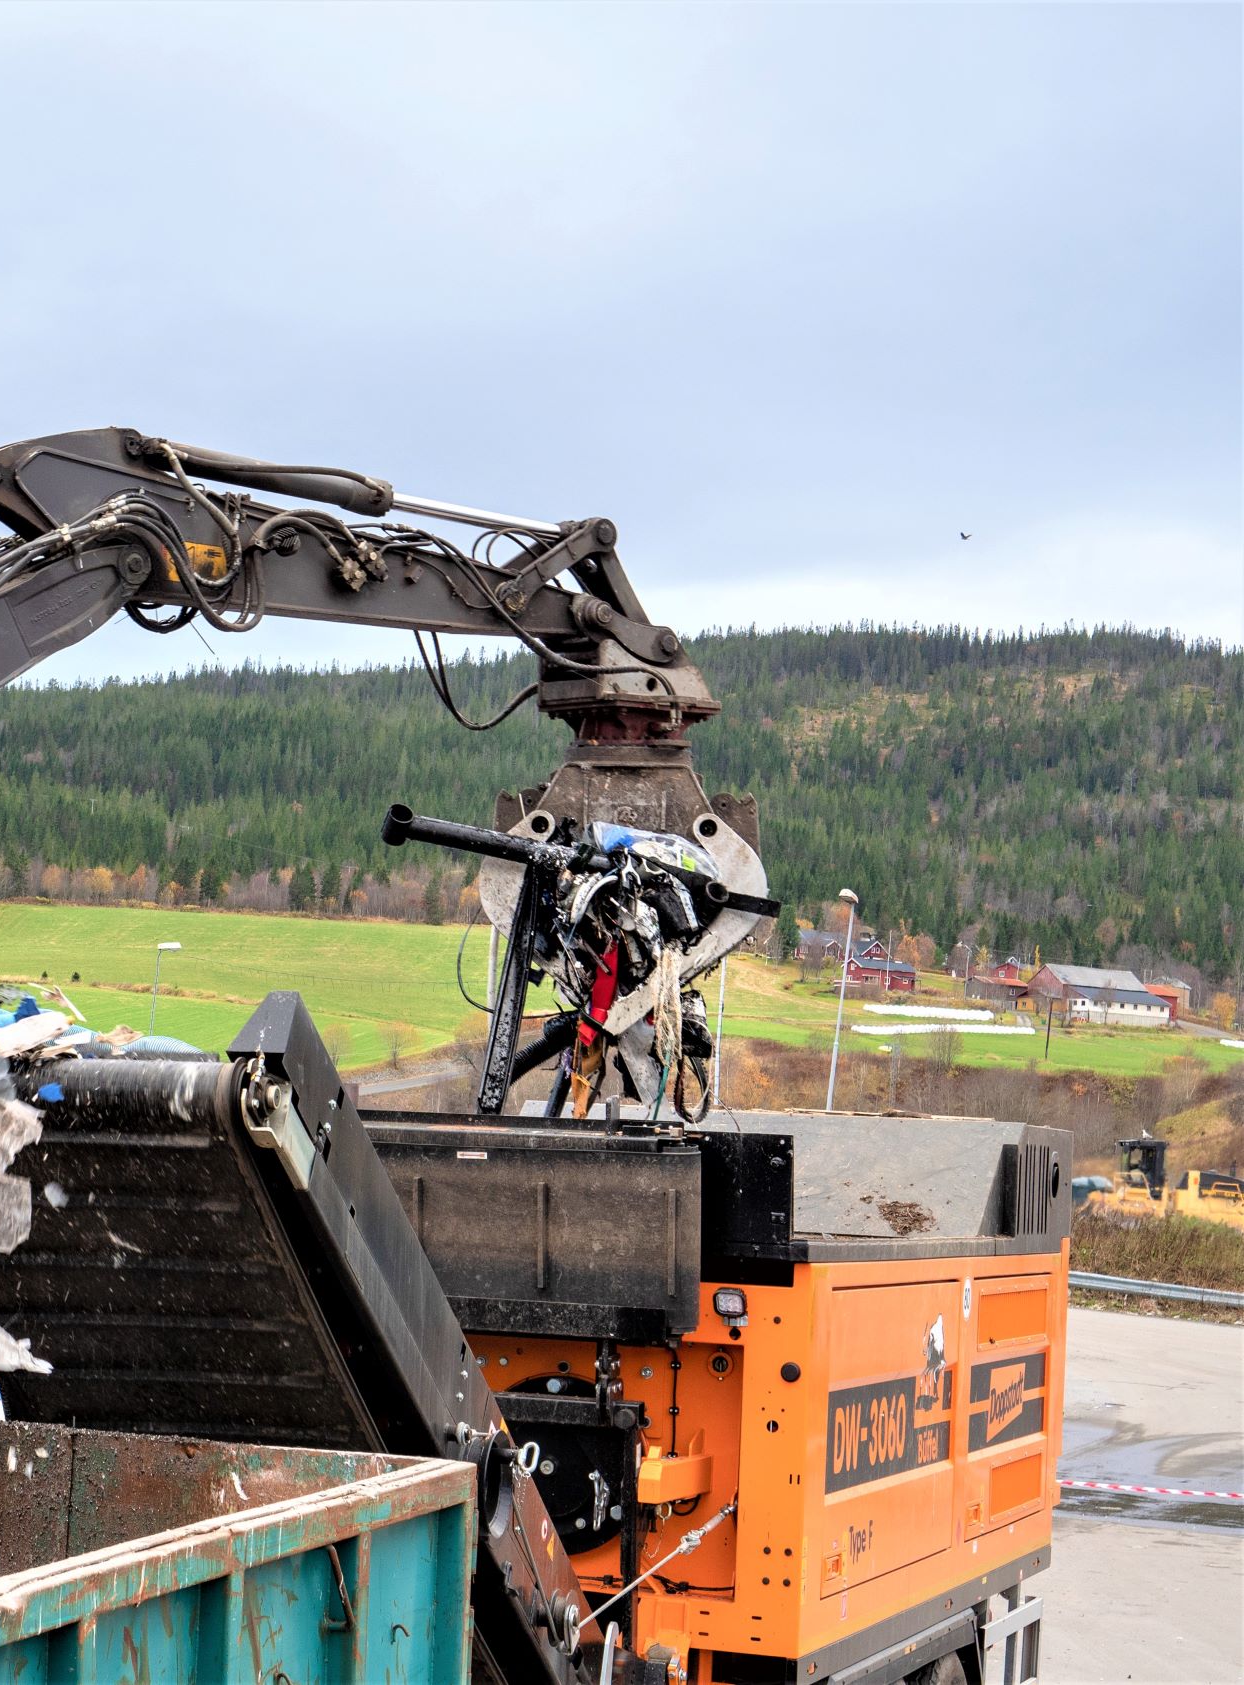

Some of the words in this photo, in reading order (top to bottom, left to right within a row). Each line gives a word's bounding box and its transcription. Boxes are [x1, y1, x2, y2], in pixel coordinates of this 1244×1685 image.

[990, 1371, 1024, 1424] Doppstadt
[833, 1393, 906, 1475] DW-3060
[917, 1428, 939, 1464] Büffel
[849, 1526, 866, 1565] Type
[868, 1519, 874, 1550] F
